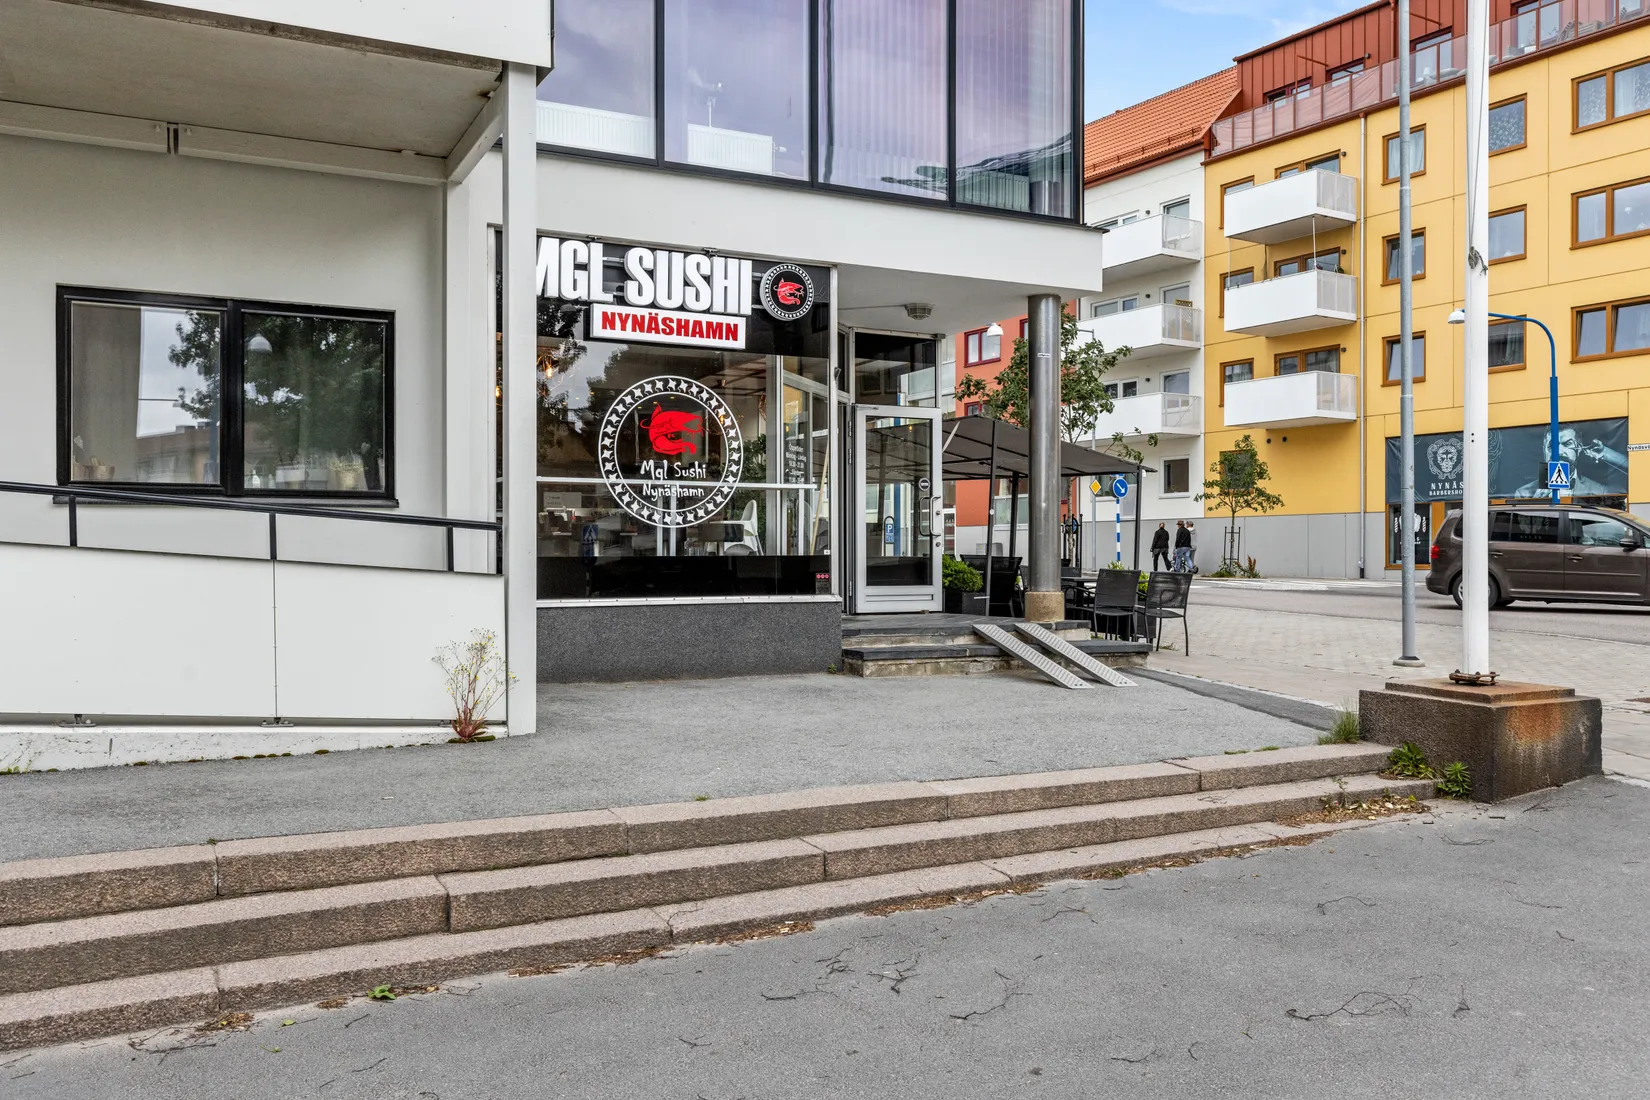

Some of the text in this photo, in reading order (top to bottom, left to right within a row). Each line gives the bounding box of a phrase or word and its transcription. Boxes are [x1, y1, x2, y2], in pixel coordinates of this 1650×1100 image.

[536, 237, 752, 315] MGL SUSHI
[602, 311, 738, 341] NYNÄSHAMN
[640, 459, 706, 484] Mgl Sushi
[642, 481, 705, 501] Nynäshamn
[1431, 480, 1464, 490] NYNÄS
[887, 524, 893, 533] P
